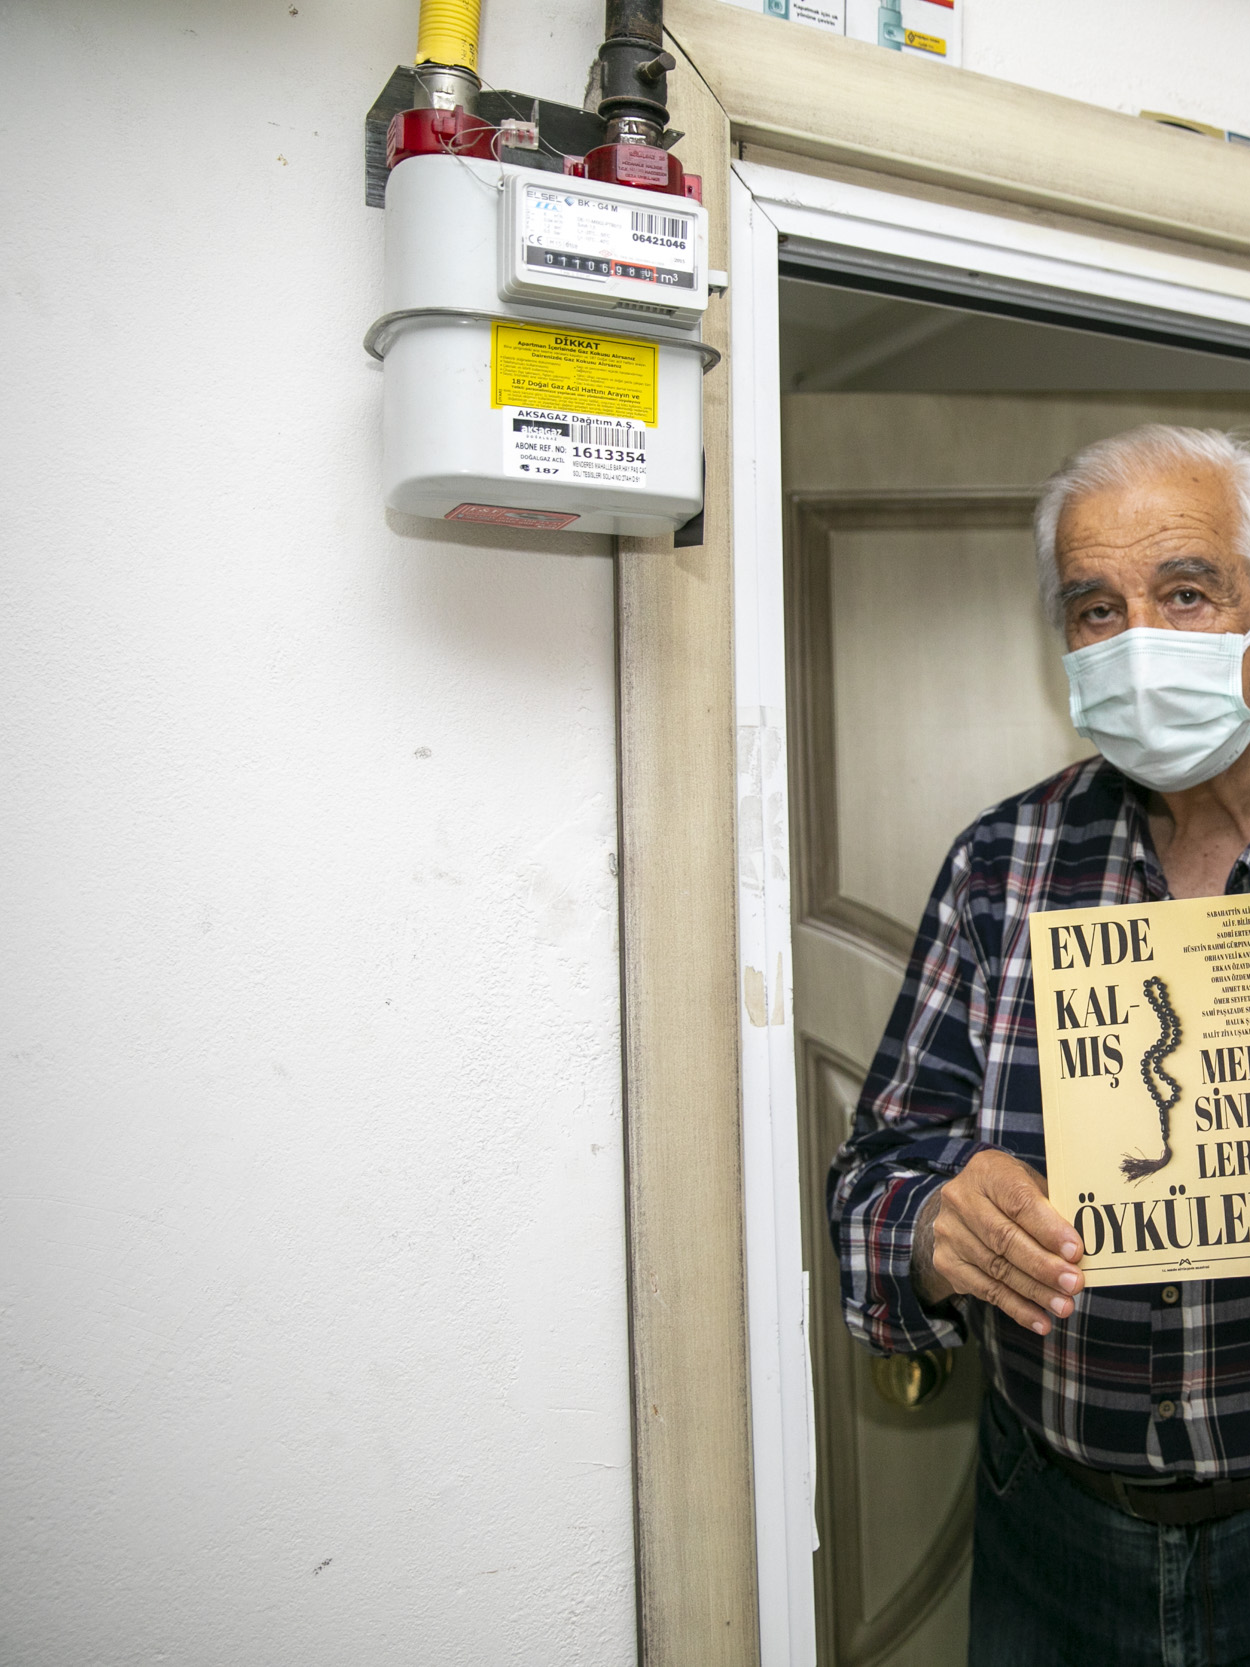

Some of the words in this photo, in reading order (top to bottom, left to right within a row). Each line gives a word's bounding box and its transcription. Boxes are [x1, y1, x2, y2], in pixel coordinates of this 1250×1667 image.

[526, 190, 562, 203] ELSEL
[578, 199, 590, 208] BK
[597, 202, 610, 212] G4
[611, 204, 618, 213] M
[632, 233, 686, 250] 06421046
[555, 336, 600, 350] DİKKAT
[518, 341, 547, 350] Apartman
[590, 350, 610, 358] Kokusu
[612, 352, 635, 361] Alırsanız
[532, 353, 562, 361] Dairenizde
[598, 360, 622, 368] Alırsanız
[528, 380, 548, 389] Doğal
[566, 384, 579, 392] Acil
[582, 386, 606, 395] Hattını
[608, 390, 630, 399] Arayın
[517, 410, 568, 422] AKSAGAZ
[572, 415, 612, 427] Dağıtım
[520, 425, 562, 436] aksagaz
[515, 442, 537, 450] ABONE
[520, 454, 550, 462] DOĞALGAZ
[572, 446, 646, 463] 1613354
[1206, 907, 1240, 918] SABAHATTİN
[1242, 906, 1250, 914] ALİ
[1222, 919, 1231, 928] ALİ
[1217, 930, 1234, 939] SADRİ
[1048, 917, 1154, 971] EVDE
[1183, 943, 1206, 953] HÜSEYİN
[1208, 942, 1226, 951] RAHMİ
[1204, 954, 1224, 962] ORHAN
[1212, 964, 1231, 972] ERKAN
[1211, 975, 1231, 983] ORHAN
[1221, 986, 1240, 994] AHMET
[1214, 996, 1230, 1005] ÖMER
[1053, 984, 1140, 1030] KAL-
[1202, 1009, 1216, 1017] SAMİ
[1217, 1007, 1244, 1017] PAŞAZADE
[1226, 1018, 1244, 1026] HALUK
[1203, 1030, 1220, 1039] HALİT
[1221, 1028, 1234, 1037] ZİYA
[1058, 1034, 1124, 1089] MIŞ
